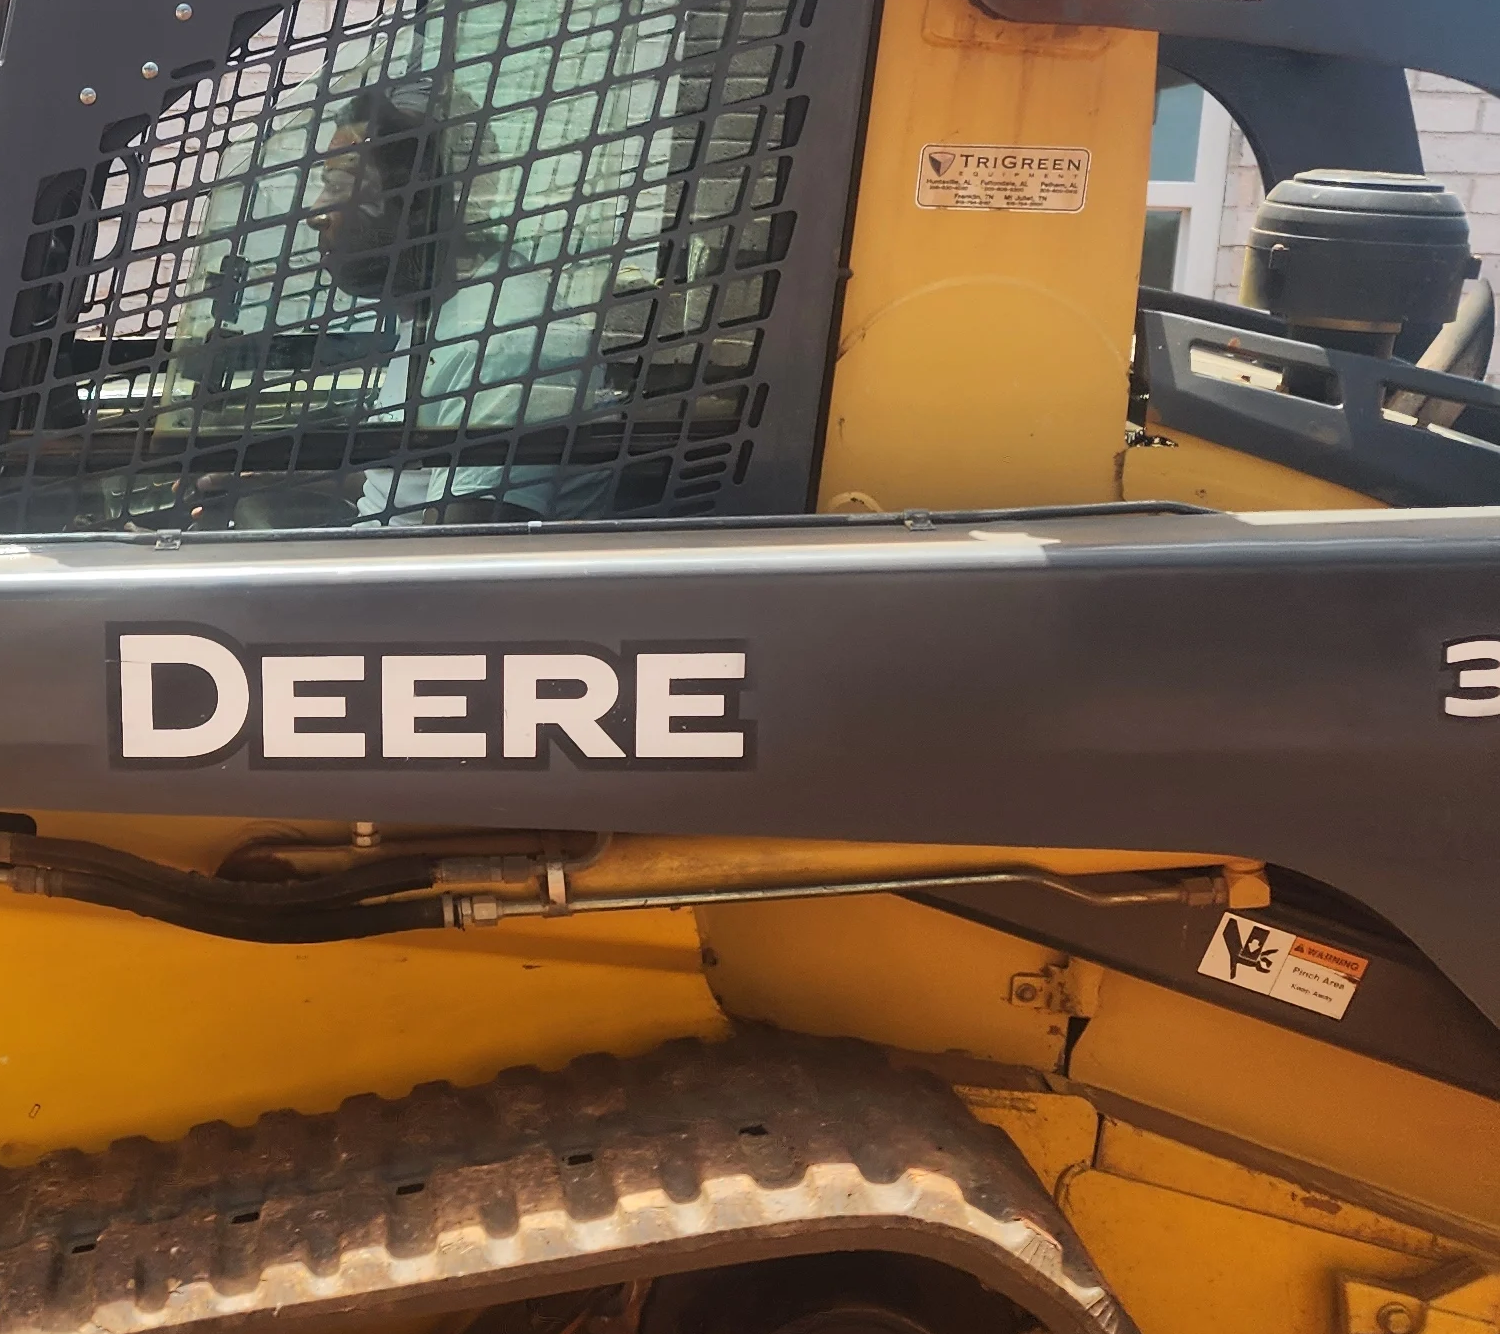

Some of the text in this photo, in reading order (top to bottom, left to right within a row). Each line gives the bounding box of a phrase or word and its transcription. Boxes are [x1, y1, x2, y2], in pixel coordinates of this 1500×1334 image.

[1444, 640, 1500, 717] 3
[119, 633, 747, 759] DEERE
[1307, 947, 1359, 971] WARNING
[1292, 966, 1346, 991] Pinch Area
[1291, 983, 1333, 1003] Keep Away
